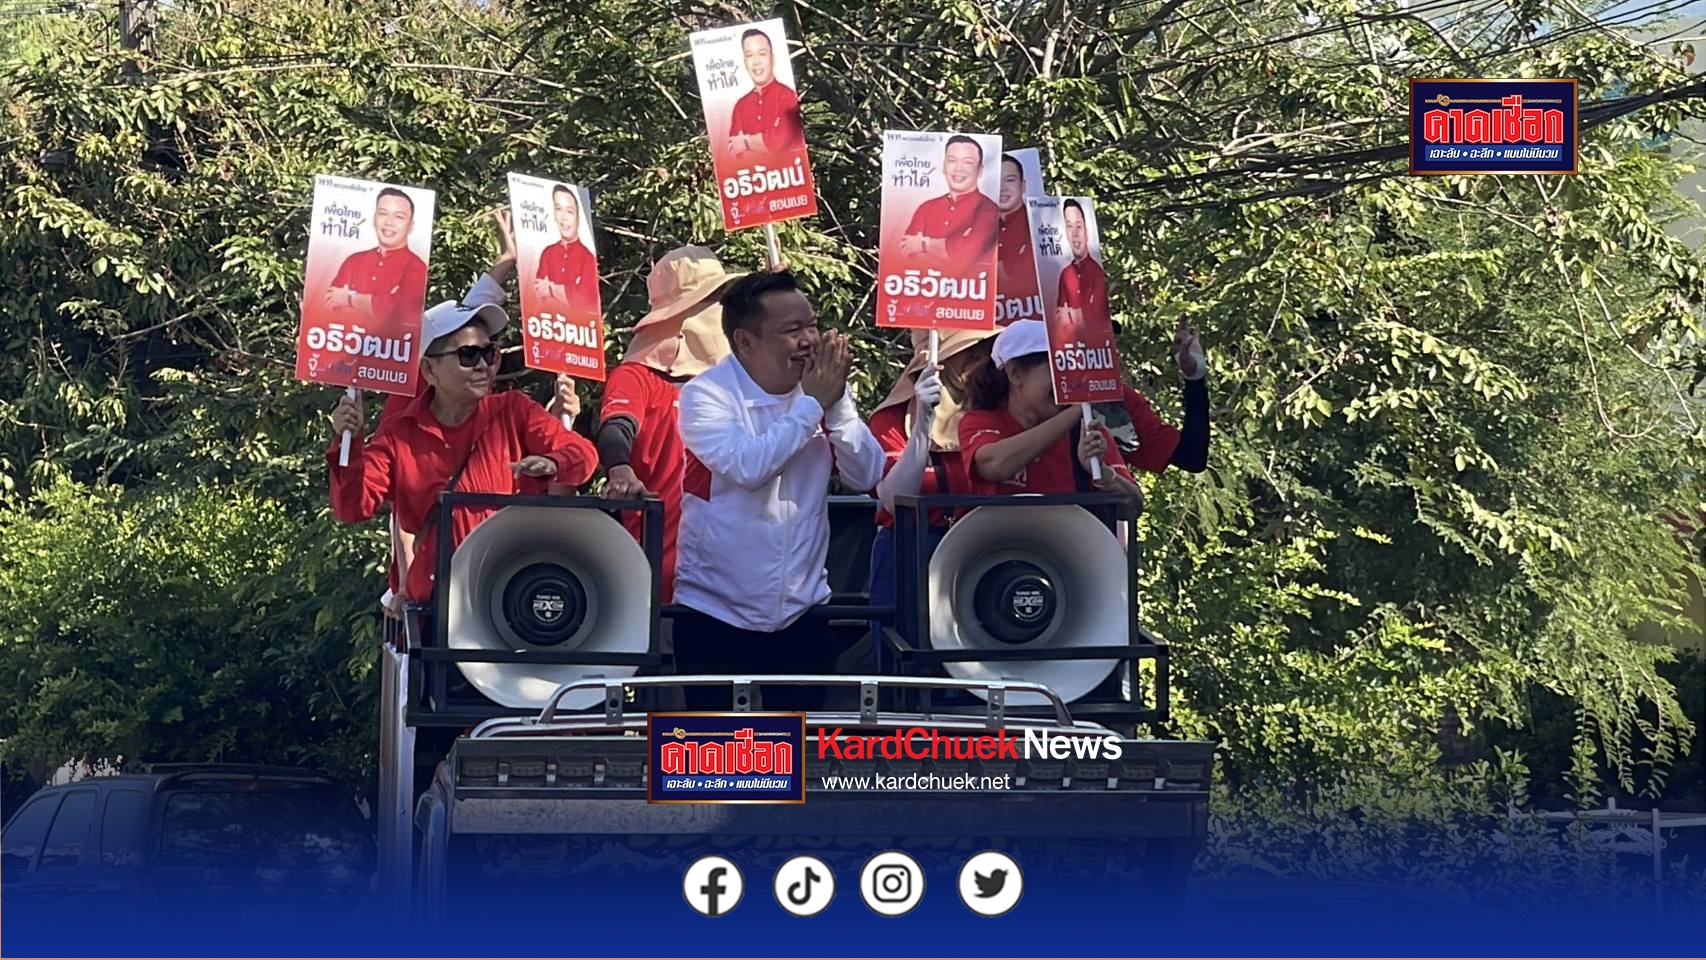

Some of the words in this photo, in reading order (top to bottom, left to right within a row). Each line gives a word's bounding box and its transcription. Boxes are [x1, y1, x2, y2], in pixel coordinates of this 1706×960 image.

[724, 157, 805, 199] อธิวัฒน์
[893, 168, 936, 187] ทำได้
[324, 201, 361, 219] เพื่อไทย
[321, 217, 367, 239] ทำได้
[884, 269, 987, 300] อธิวัฒน์
[936, 307, 985, 320] สอนเนย
[307, 323, 412, 362] อธิวัฒน์
[527, 312, 598, 349] อธิวัฒน์
[1055, 340, 1114, 371] อธิวัฒน์
[357, 366, 408, 384] สอนเนย
